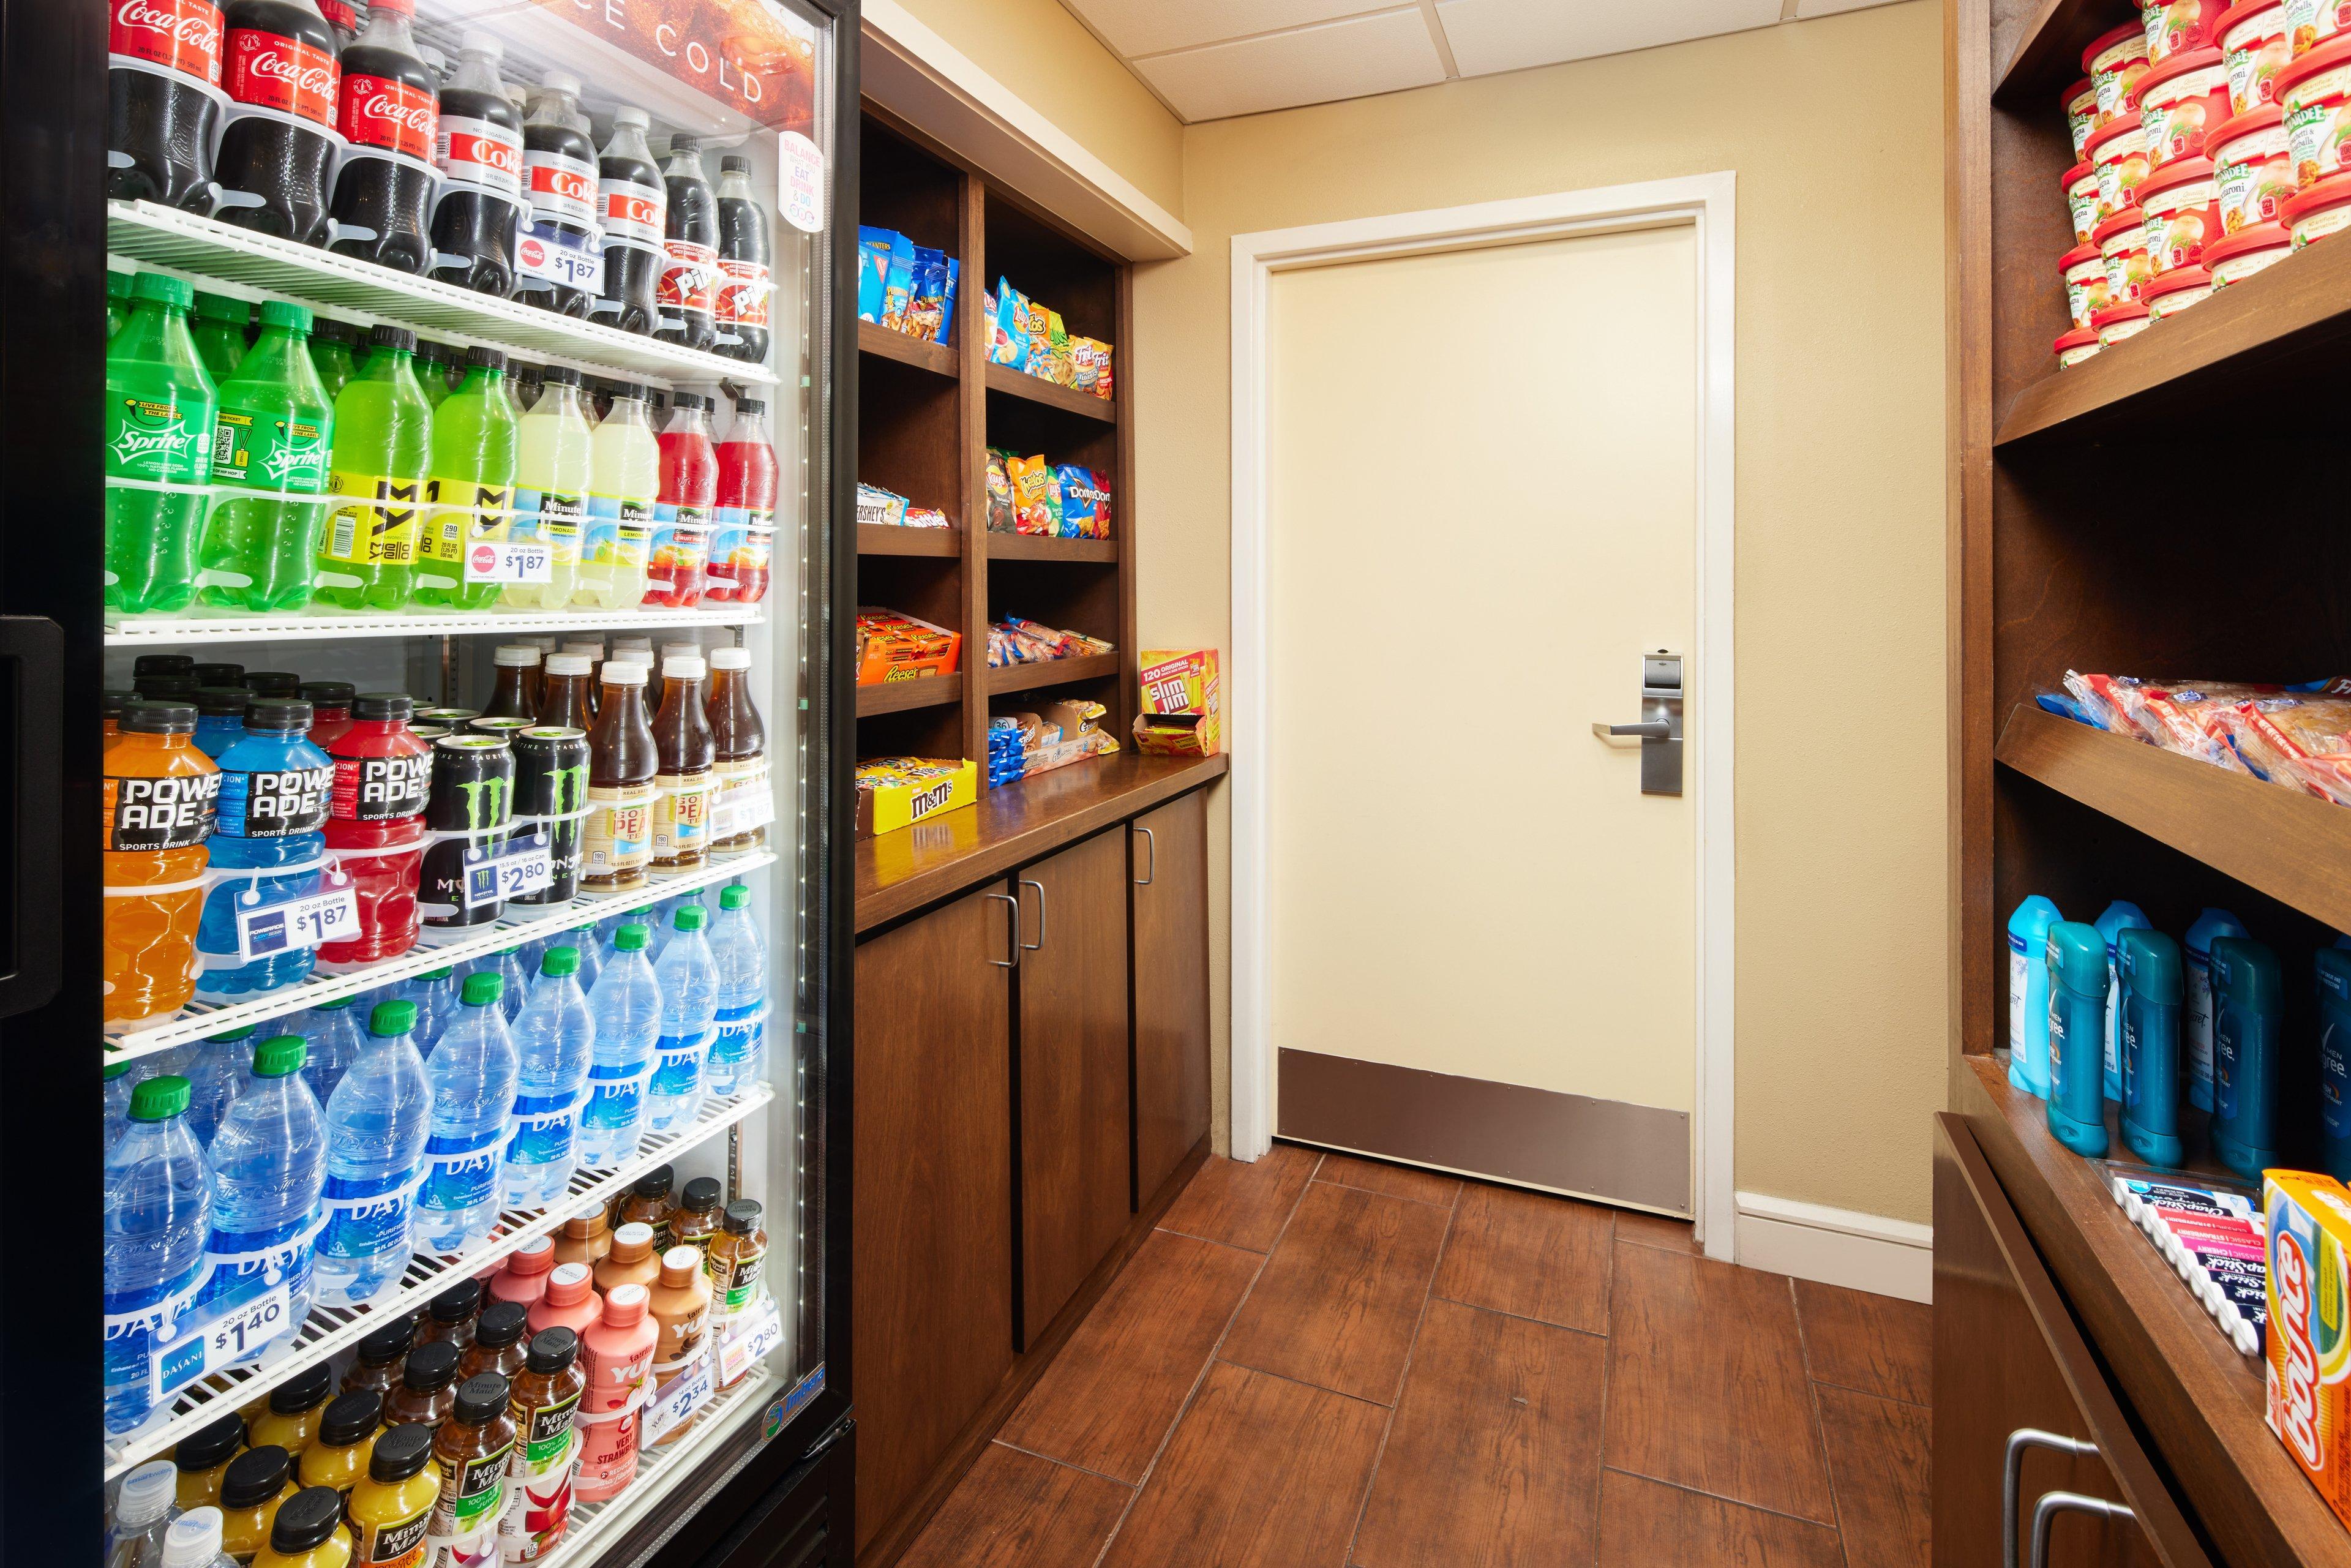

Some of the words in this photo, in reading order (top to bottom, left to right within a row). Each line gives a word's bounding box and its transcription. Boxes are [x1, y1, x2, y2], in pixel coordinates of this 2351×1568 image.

[189, 2, 209, 15] TASTE
[118, 0, 220, 55] Coca-Cola
[274, 40, 310, 56] ORIGINAL
[312, 53, 330, 66] TASTE
[656, 24, 762, 103] COLD
[250, 51, 337, 102] Coca-Cola
[364, 94, 438, 139] Coca-Cola
[471, 140, 522, 178] Coke
[784, 138, 821, 168] BALANCE
[795, 166, 809, 182] EAT
[551, 172, 598, 208] Coke
[790, 176, 814, 197] DRINK
[577, 254, 594, 264] Bottle
[118, 431, 184, 451] Sprite
[268, 449, 320, 468] Sprite
[545, 501, 581, 514] Minute
[1143, 669, 1161, 682] 120
[1161, 659, 1188, 672] ORIGINAL
[1150, 679, 1185, 702] slim
[1160, 692, 1189, 715] jim
[364, 778, 421, 803] ADE
[253, 792, 317, 818] ADE
[121, 803, 197, 829] ADE
[252, 828, 287, 838] SPORTS
[162, 839, 190, 849] DRINK
[323, 896, 345, 906] Bottle
[249, 923, 285, 936] POWERADE
[2327, 1046, 2342, 1061] MEN
[2151, 1199, 2224, 1216] ChapStick
[2177, 1228, 2225, 1241] STRAWBERRY
[2230, 1236, 2262, 1245] CLASSIC
[2197, 1245, 2227, 1255] CHERRY
[2232, 1251, 2265, 1262] CLASSIC
[223, 1318, 234, 1328] 20
[237, 1311, 248, 1321] oz
[251, 1295, 277, 1313] Bottle
[111, 1364, 139, 1372] Enhanced
[163, 1351, 203, 1379] DASANI
[469, 1386, 494, 1395] Maid
[691, 1374, 705, 1388] Bottle
[617, 1430, 634, 1449] VERY
[126, 1466, 172, 1485] smartwater
[468, 1495, 486, 1506] 100%
